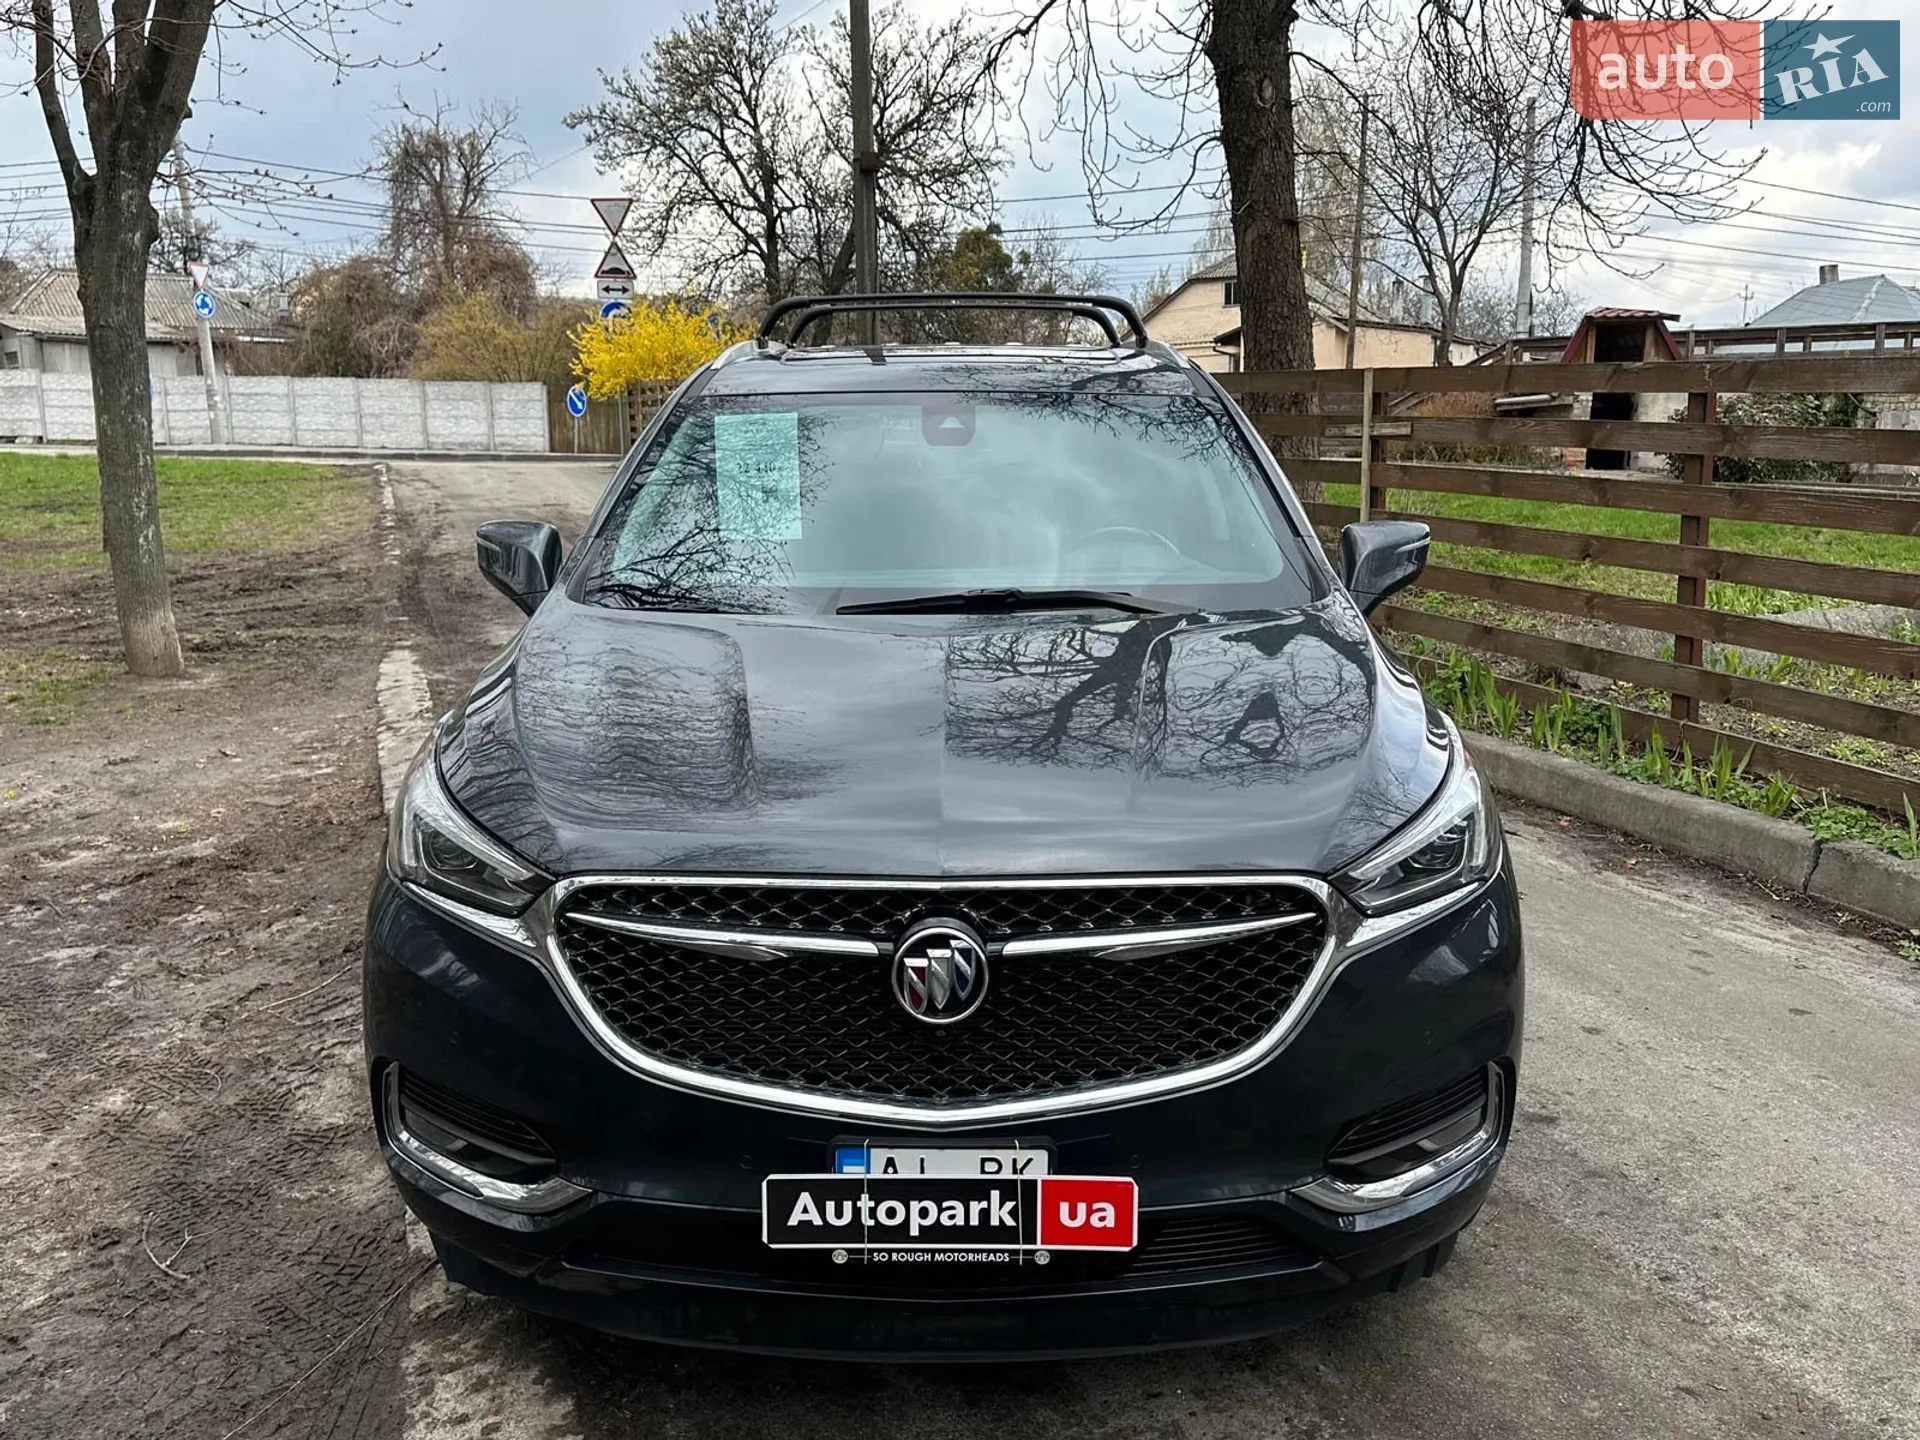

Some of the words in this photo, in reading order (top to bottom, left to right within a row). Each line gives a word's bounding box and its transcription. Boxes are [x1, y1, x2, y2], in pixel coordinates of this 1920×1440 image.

[787, 1190, 1017, 1237] Autopark
[1058, 1201, 1116, 1229] ua
[873, 1252, 889, 1262] SO
[891, 1252, 932, 1262] ROUGH
[934, 1252, 1010, 1262] MOTORHEADS
